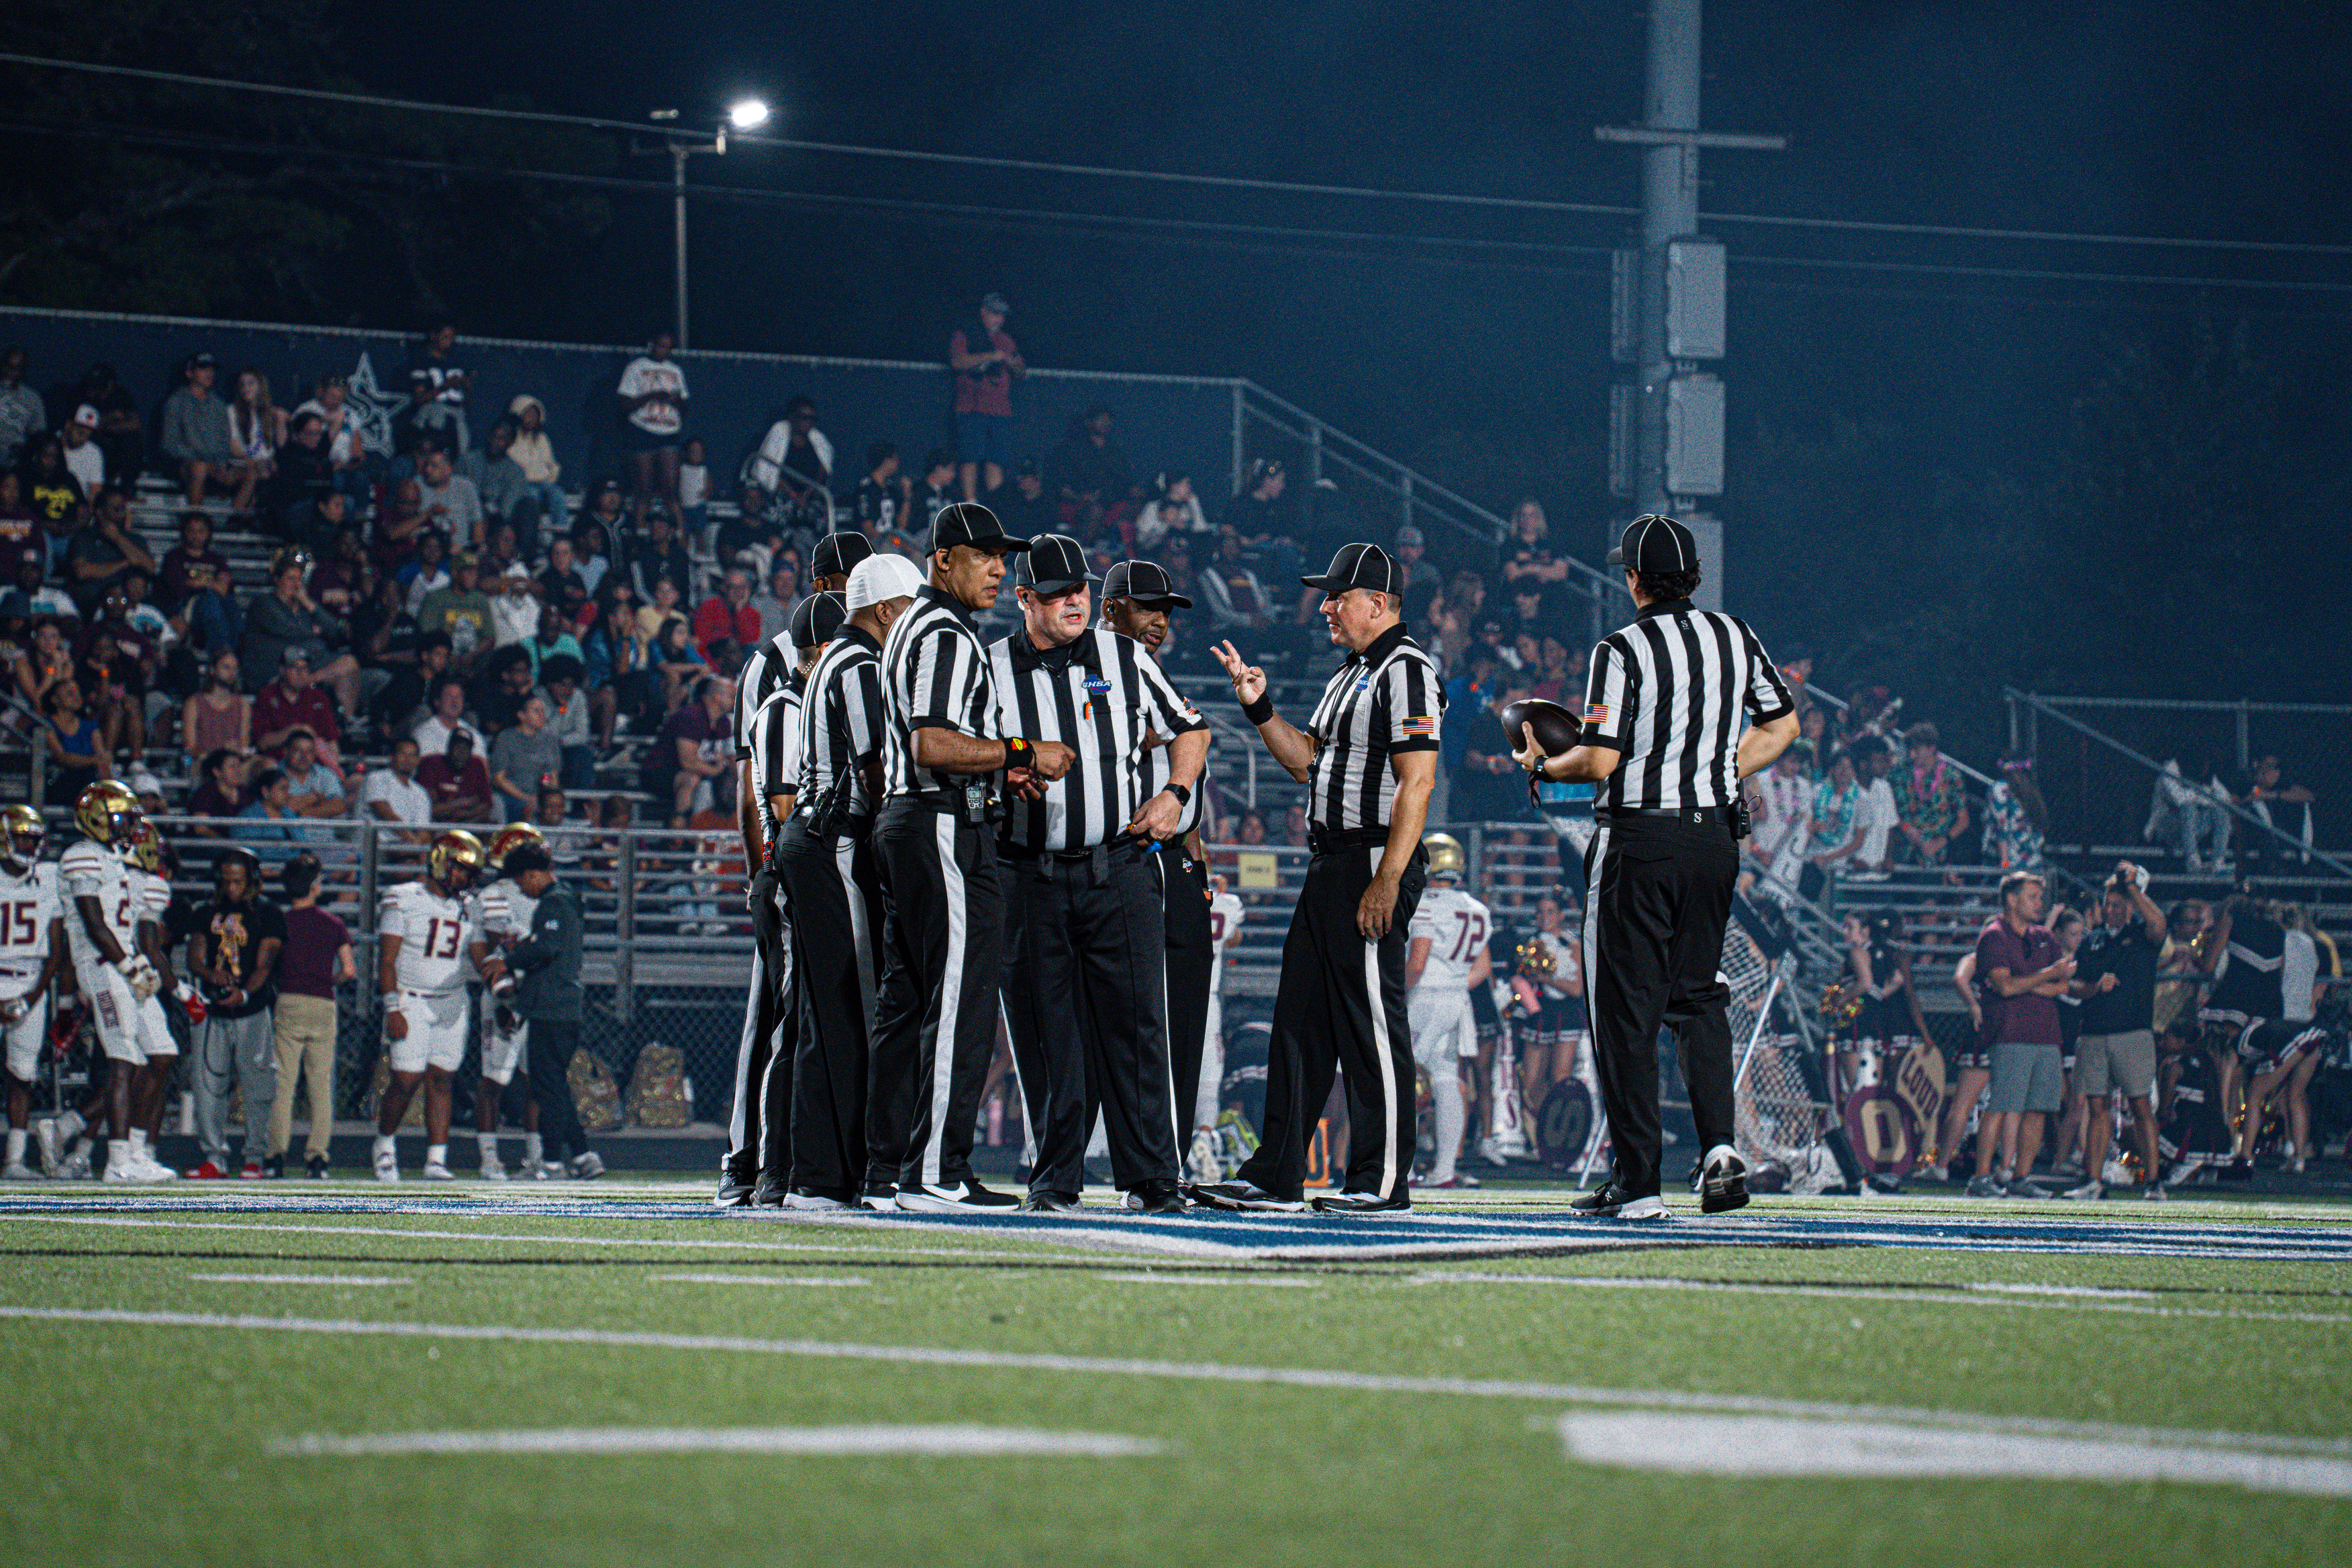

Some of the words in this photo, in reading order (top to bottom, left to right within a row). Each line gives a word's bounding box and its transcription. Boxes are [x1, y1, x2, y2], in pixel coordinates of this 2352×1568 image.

[0, 901, 36, 944] 15
[424, 918, 460, 959] 13
[1450, 912, 1484, 962] 72
[1902, 1052, 1939, 1120] LOUD
